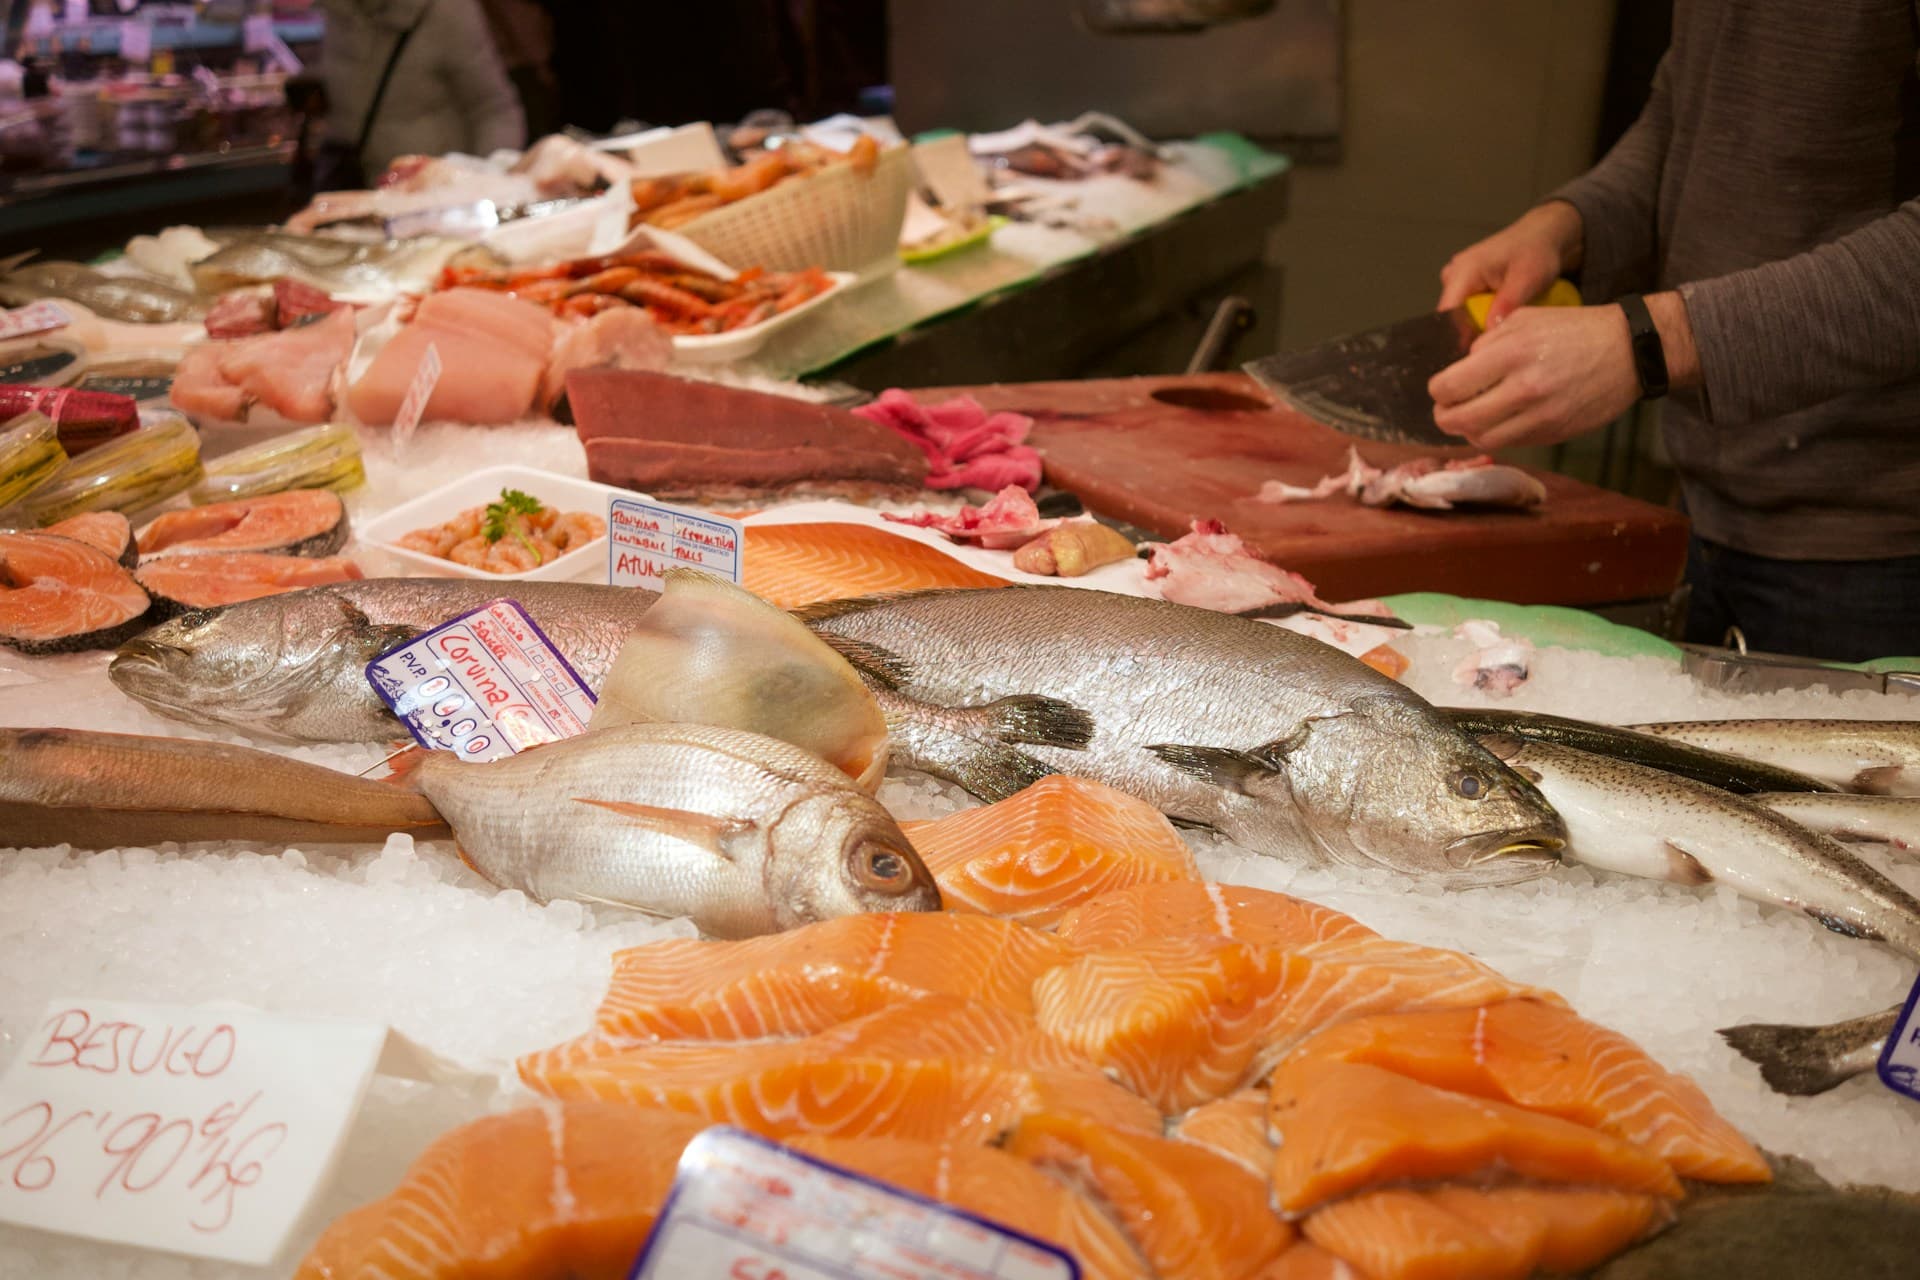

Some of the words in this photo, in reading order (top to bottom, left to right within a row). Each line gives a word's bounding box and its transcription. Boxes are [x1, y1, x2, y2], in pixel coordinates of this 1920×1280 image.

[399, 651, 428, 678] P.V.P.
[439, 635, 510, 704] Corvina
[28, 1008, 237, 1078] BESUGO
